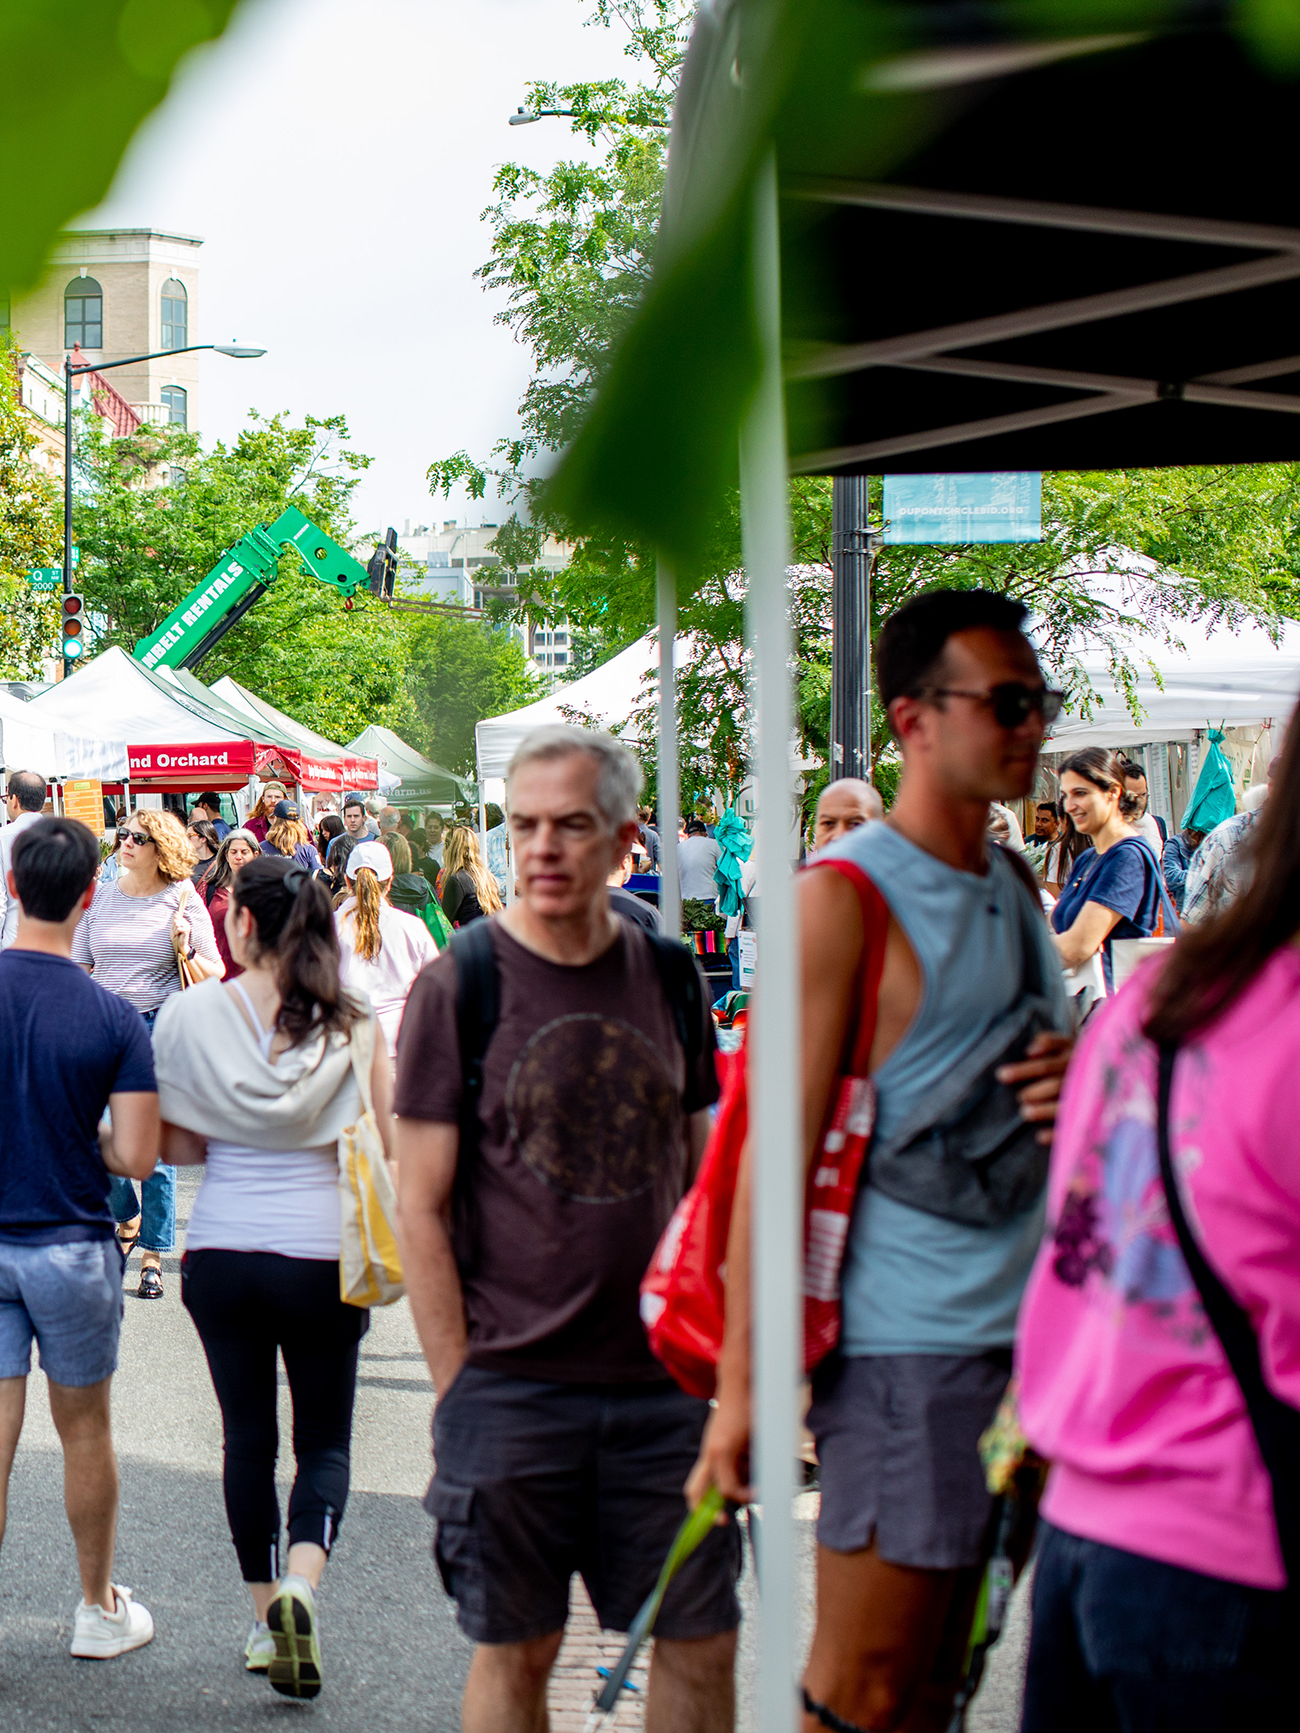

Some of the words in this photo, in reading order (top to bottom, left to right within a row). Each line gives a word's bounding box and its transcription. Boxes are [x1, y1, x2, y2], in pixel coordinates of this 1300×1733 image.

[900, 506, 1024, 515] DUPONTCIRCLEBID.ORG
[32, 570, 43, 581] Q
[33, 582, 54, 590] 2000
[180, 561, 244, 627] RENTALS
[156, 752, 228, 768] Orchard
